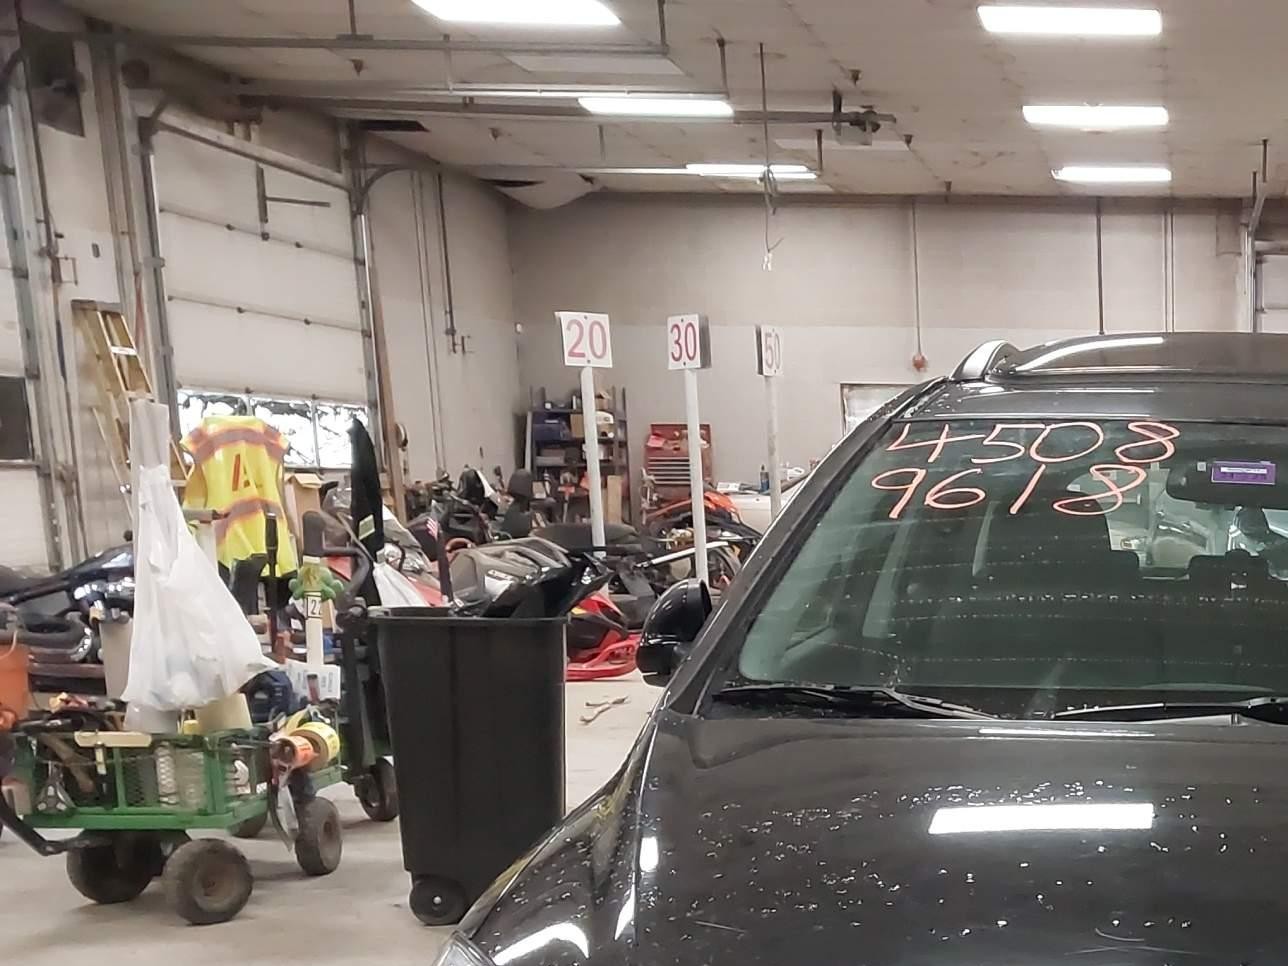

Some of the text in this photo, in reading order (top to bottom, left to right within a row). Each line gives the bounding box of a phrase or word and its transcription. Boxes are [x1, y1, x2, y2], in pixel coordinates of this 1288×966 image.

[565, 318, 608, 360] 20
[670, 321, 698, 363] 30
[763, 331, 782, 371] 50
[885, 420, 1182, 464] 4508
[870, 463, 1149, 520] 9618
